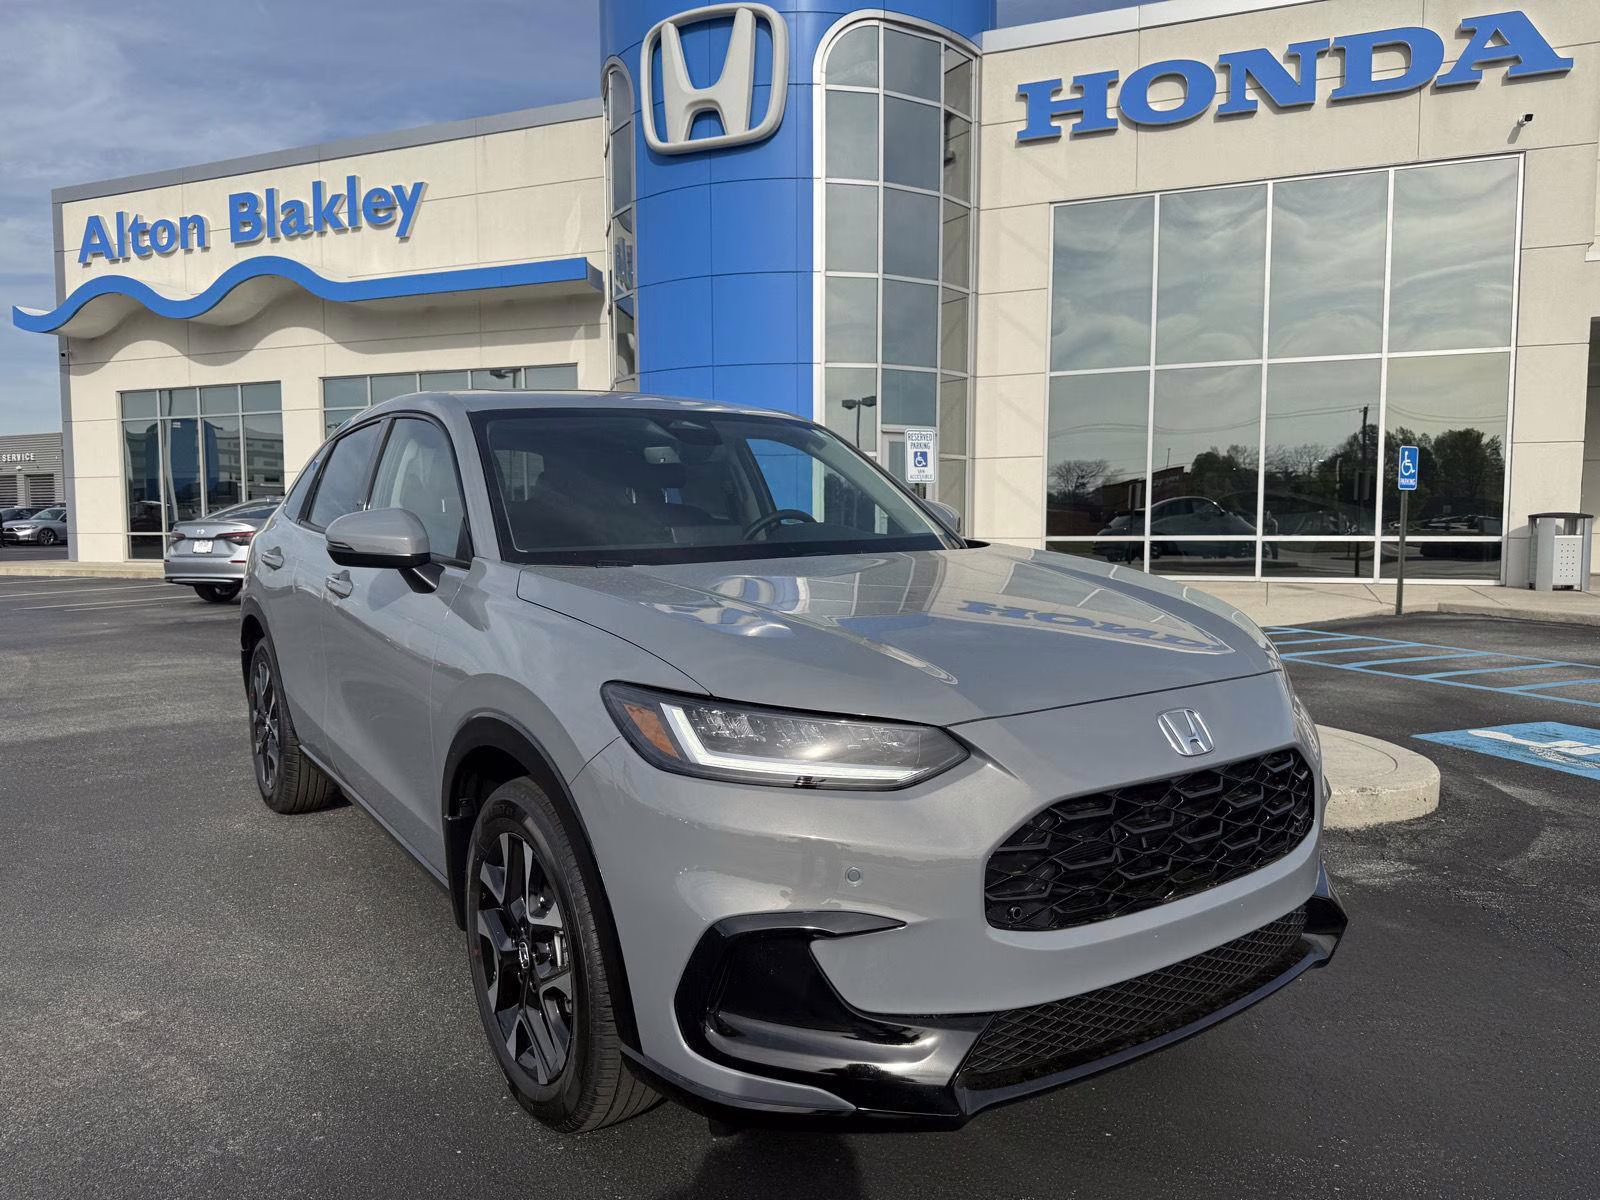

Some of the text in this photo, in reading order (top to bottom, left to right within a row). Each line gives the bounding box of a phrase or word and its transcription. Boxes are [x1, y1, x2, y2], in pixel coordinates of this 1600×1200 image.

[1017, 11, 1574, 141] HONDA
[78, 175, 426, 265] Alton Blakley
[2, 453, 35, 462] SERVICE
[908, 433, 933, 441] RESERVED
